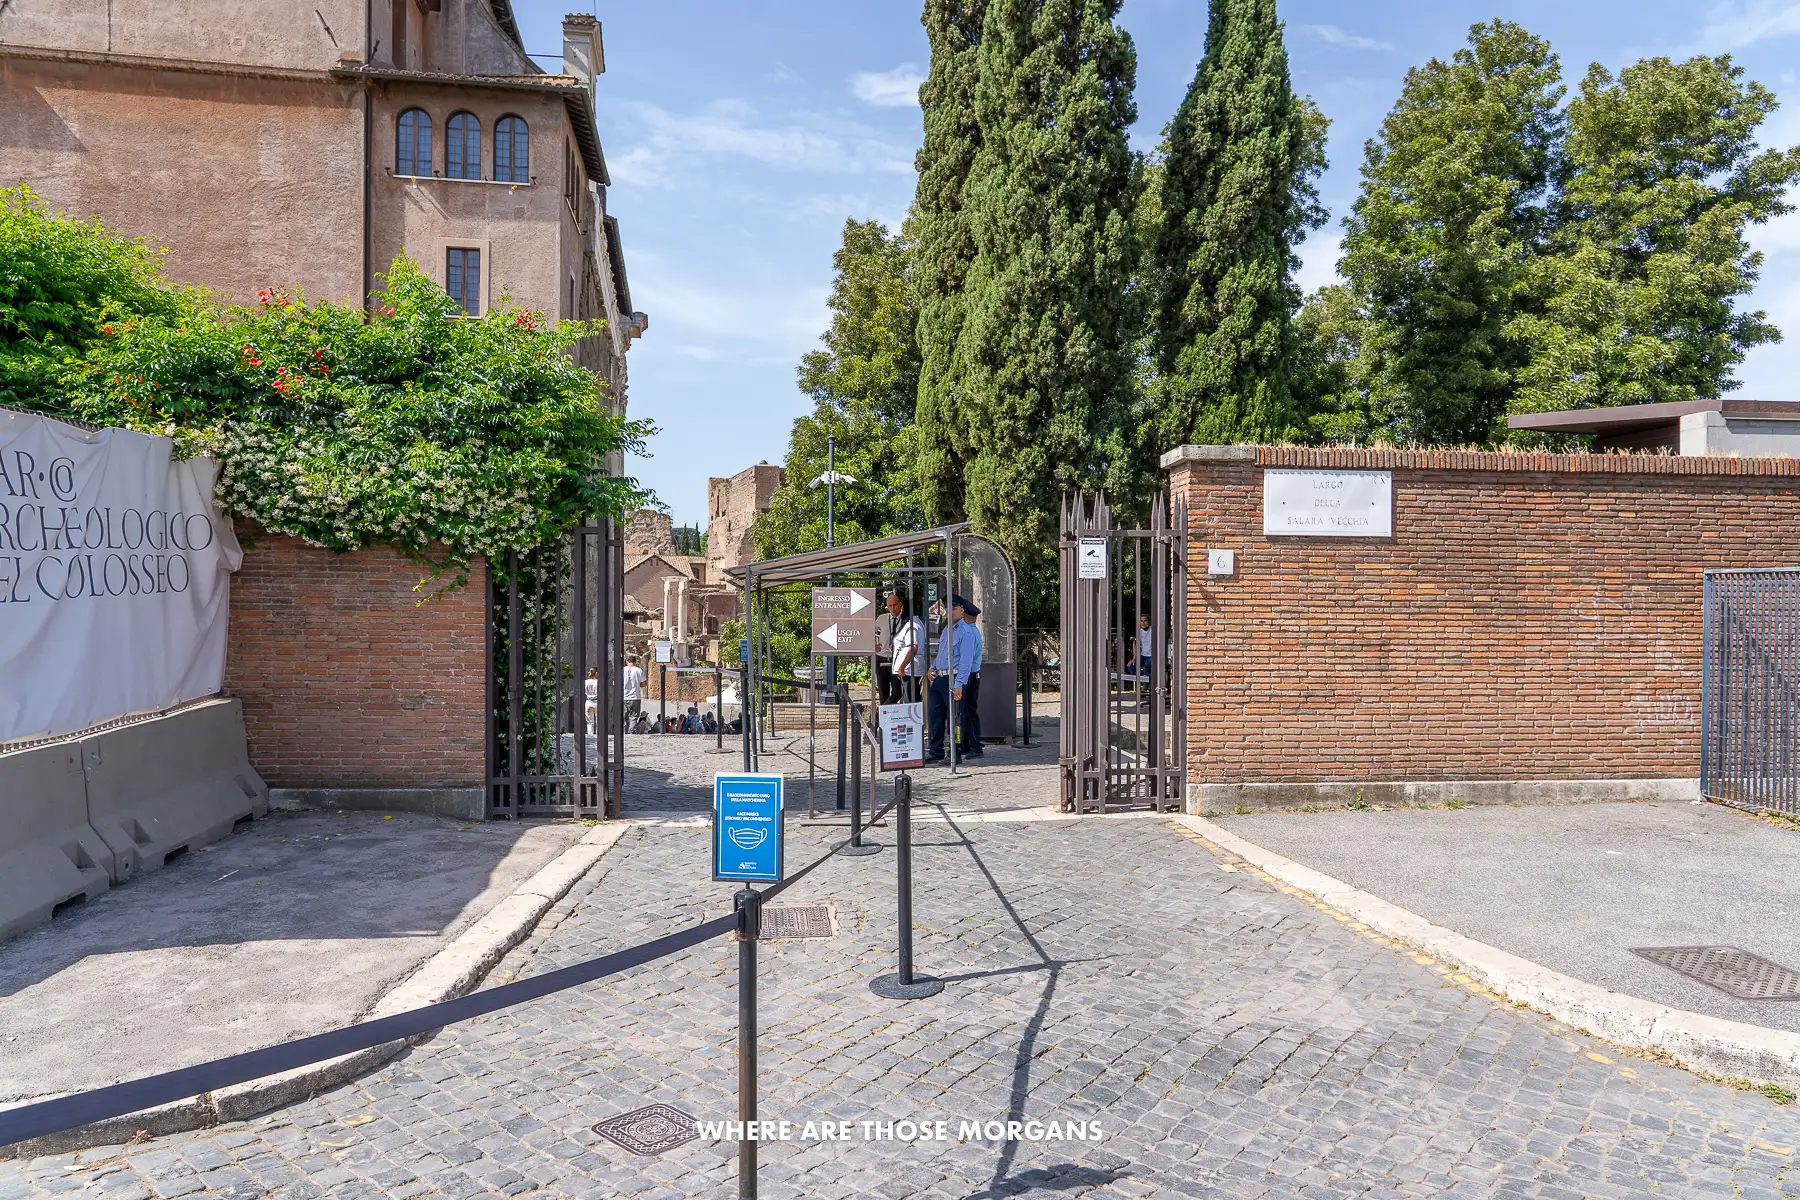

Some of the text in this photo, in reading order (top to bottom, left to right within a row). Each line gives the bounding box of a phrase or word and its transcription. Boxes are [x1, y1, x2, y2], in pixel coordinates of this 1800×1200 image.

[1313, 480, 1344, 490] LARGO
[1314, 499, 1342, 508] DELLA
[1287, 516, 1369, 526] SALARA VECCHIA
[1217, 555, 1226, 569] 6
[36, 554, 190, 601] COLOSSEO
